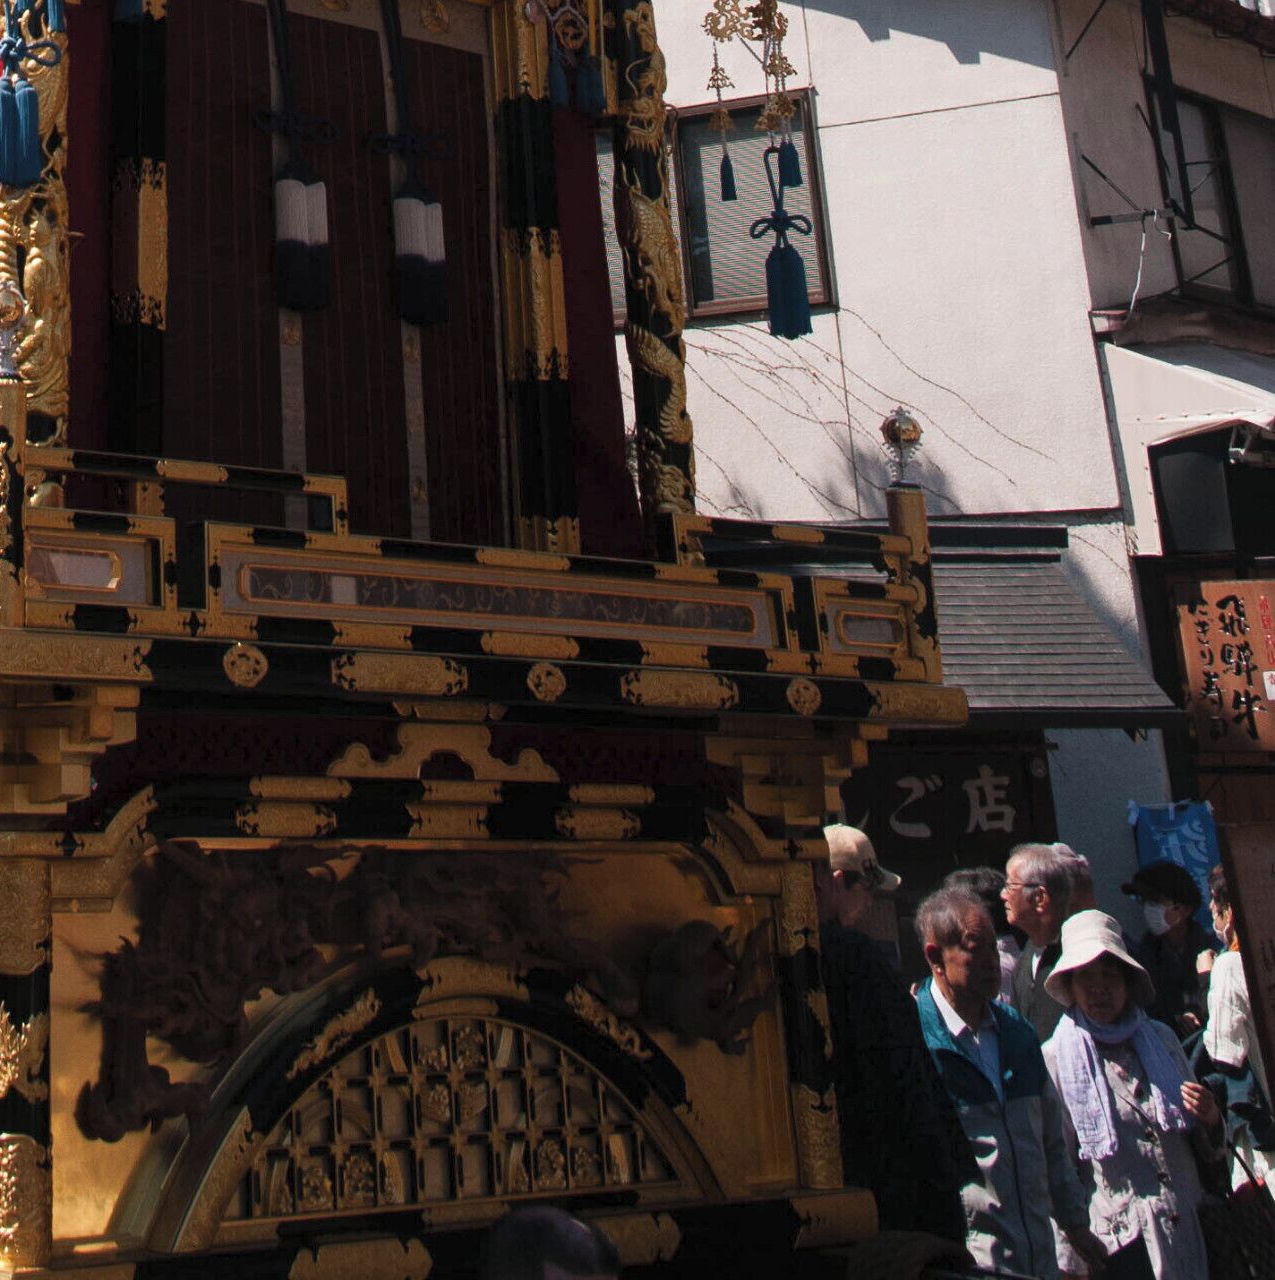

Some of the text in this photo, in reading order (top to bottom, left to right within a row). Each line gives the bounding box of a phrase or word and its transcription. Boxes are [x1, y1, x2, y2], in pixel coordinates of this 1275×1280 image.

[1216, 594, 1268, 740] 飛騨牛
[859, 764, 1017, 838] ご店
